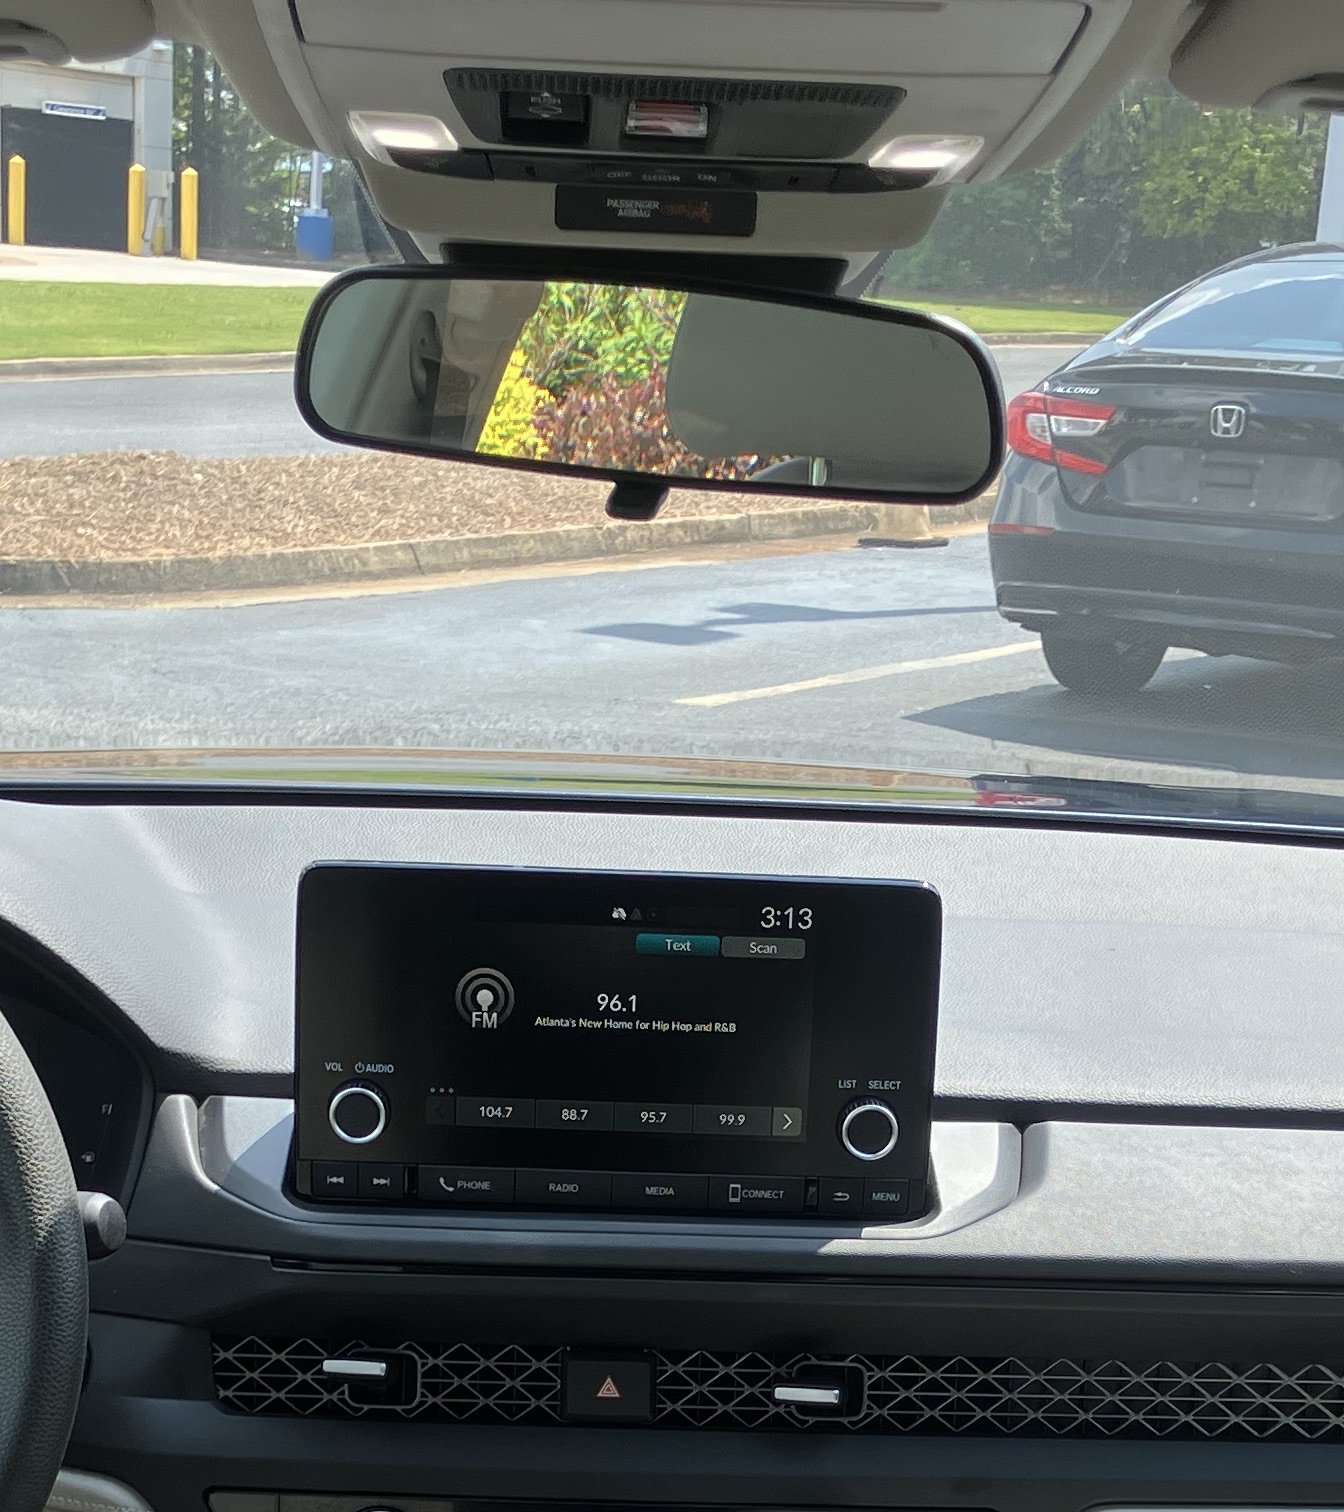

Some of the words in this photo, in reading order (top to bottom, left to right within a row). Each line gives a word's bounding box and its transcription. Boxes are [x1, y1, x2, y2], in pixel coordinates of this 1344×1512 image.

[607, 199, 660, 209] PASSENGER
[1052, 386, 1100, 395] ACCORD
[760, 907, 813, 930] 3:13
[664, 939, 692, 953] Text
[749, 942, 777, 955] Scan
[596, 993, 638, 1013] 96.1
[471, 1011, 498, 1029] FM
[534, 1016, 576, 1028] Atlanta's
[578, 1018, 602, 1028] New
[604, 1019, 633, 1029] Home
[635, 1020, 650, 1030] for
[652, 1020, 669, 1032] Hip
[672, 1021, 692, 1033] Hop
[694, 1022, 712, 1032] and
[714, 1023, 736, 1033] R&B
[325, 1062, 343, 1072] VOL
[365, 1063, 395, 1073] AUDIO
[838, 1080, 856, 1089] LIST
[868, 1080, 901, 1090] SELECT
[479, 1105, 513, 1119] 104.7
[561, 1108, 588, 1122] 88.7
[640, 1110, 667, 1124] 95.7
[719, 1113, 746, 1127] 99.9
[457, 1180, 491, 1190] PHONE
[548, 1183, 579, 1193] RADIO
[645, 1186, 674, 1196] MEDIA
[742, 1190, 785, 1199] CONNECT
[872, 1192, 900, 1202] MENU
